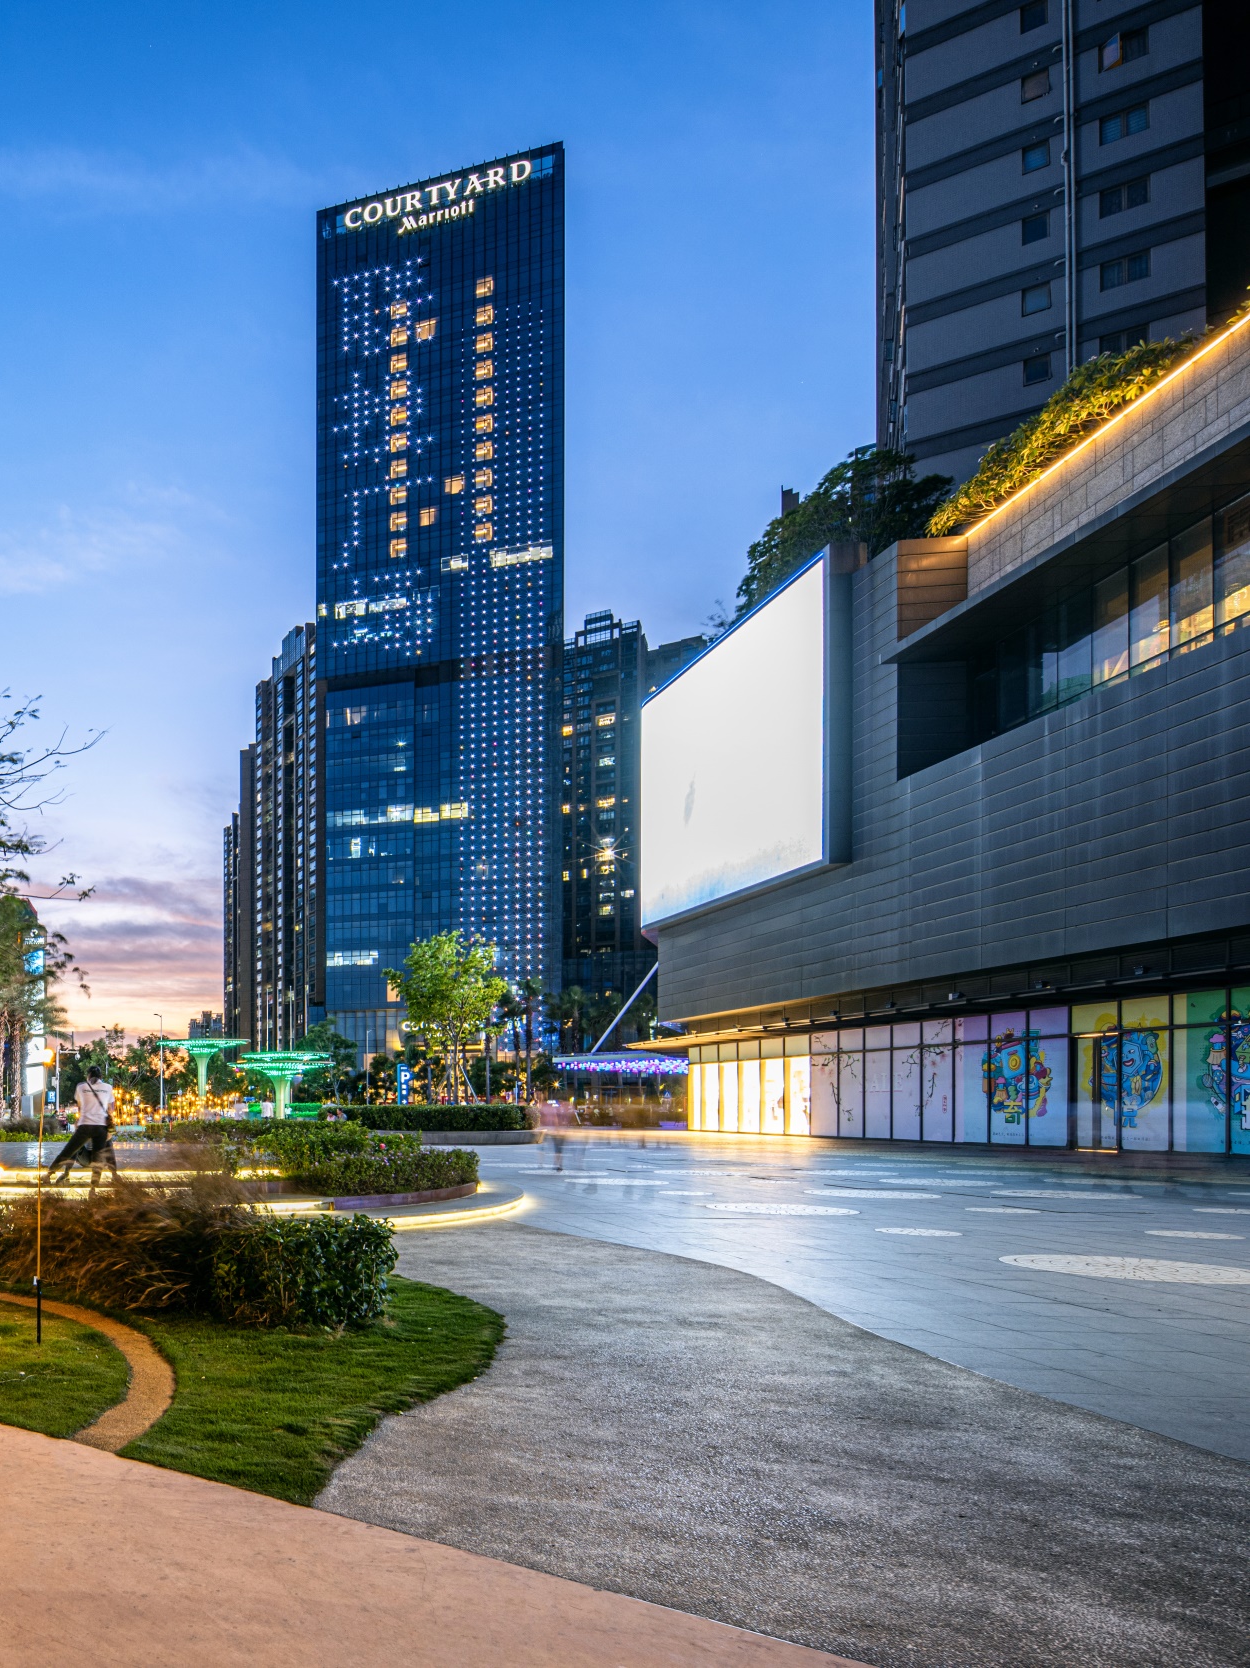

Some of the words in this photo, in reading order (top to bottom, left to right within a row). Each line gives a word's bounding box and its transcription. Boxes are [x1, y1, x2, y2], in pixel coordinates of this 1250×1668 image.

[344, 160, 532, 229] COURTYARD
[398, 198, 475, 235] Marriott
[1003, 1101, 1023, 1126] 奇
